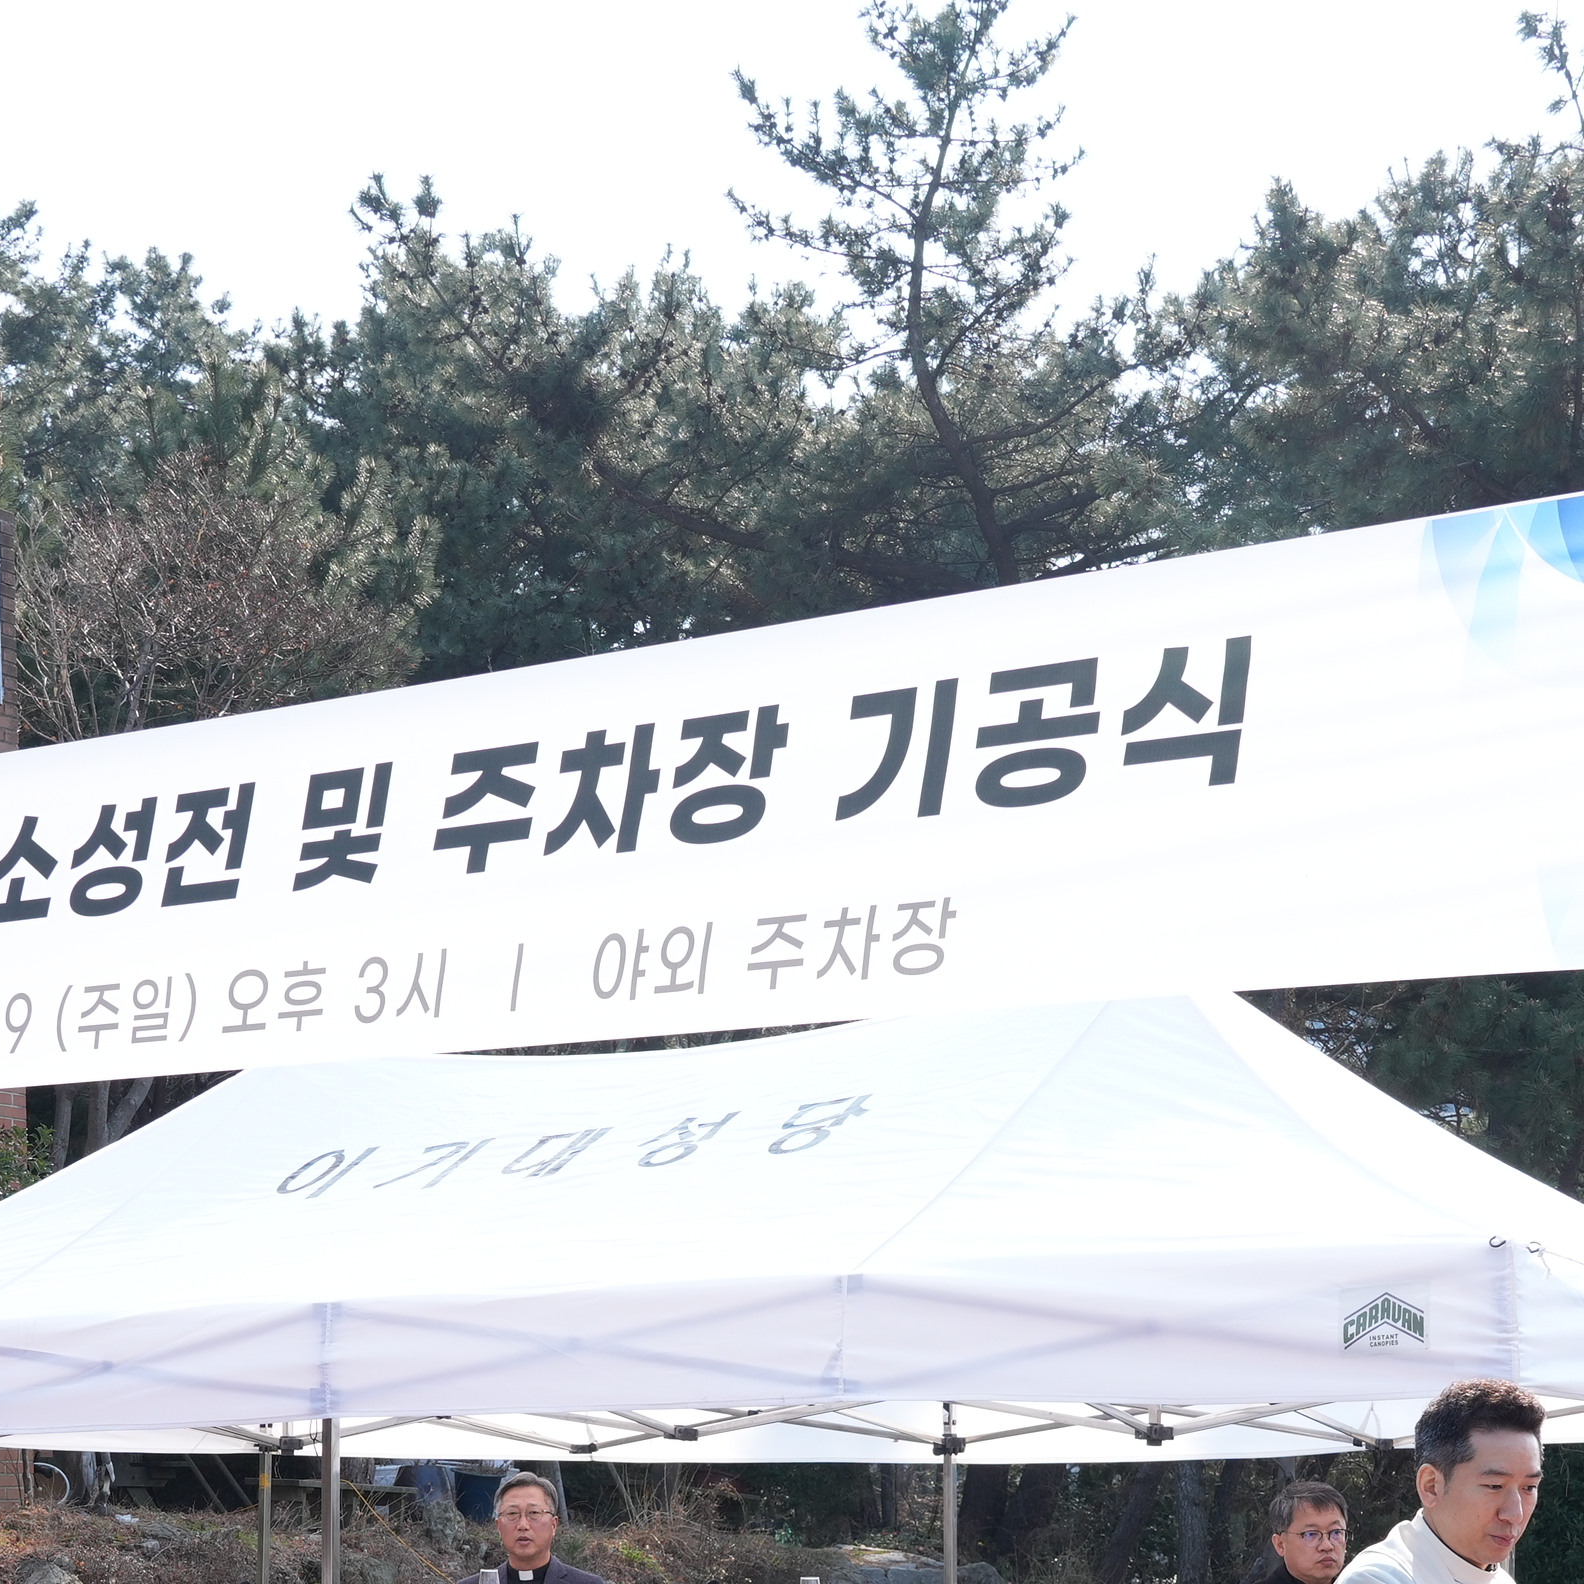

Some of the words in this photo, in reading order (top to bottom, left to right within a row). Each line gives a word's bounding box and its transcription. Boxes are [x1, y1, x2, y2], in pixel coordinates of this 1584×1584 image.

[292, 761, 393, 892] 및
[433, 704, 789, 874] 주차장
[835, 635, 1252, 821] 기공식
[6, 993, 32, 1053] 9
[57, 973, 196, 1052] (주일)
[222, 961, 326, 1033] 오후
[355, 949, 447, 1023] 3시
[593, 922, 713, 1000] 야외
[747, 897, 956, 989] 주차장
[1343, 1297, 1424, 1344] CARAVAN
